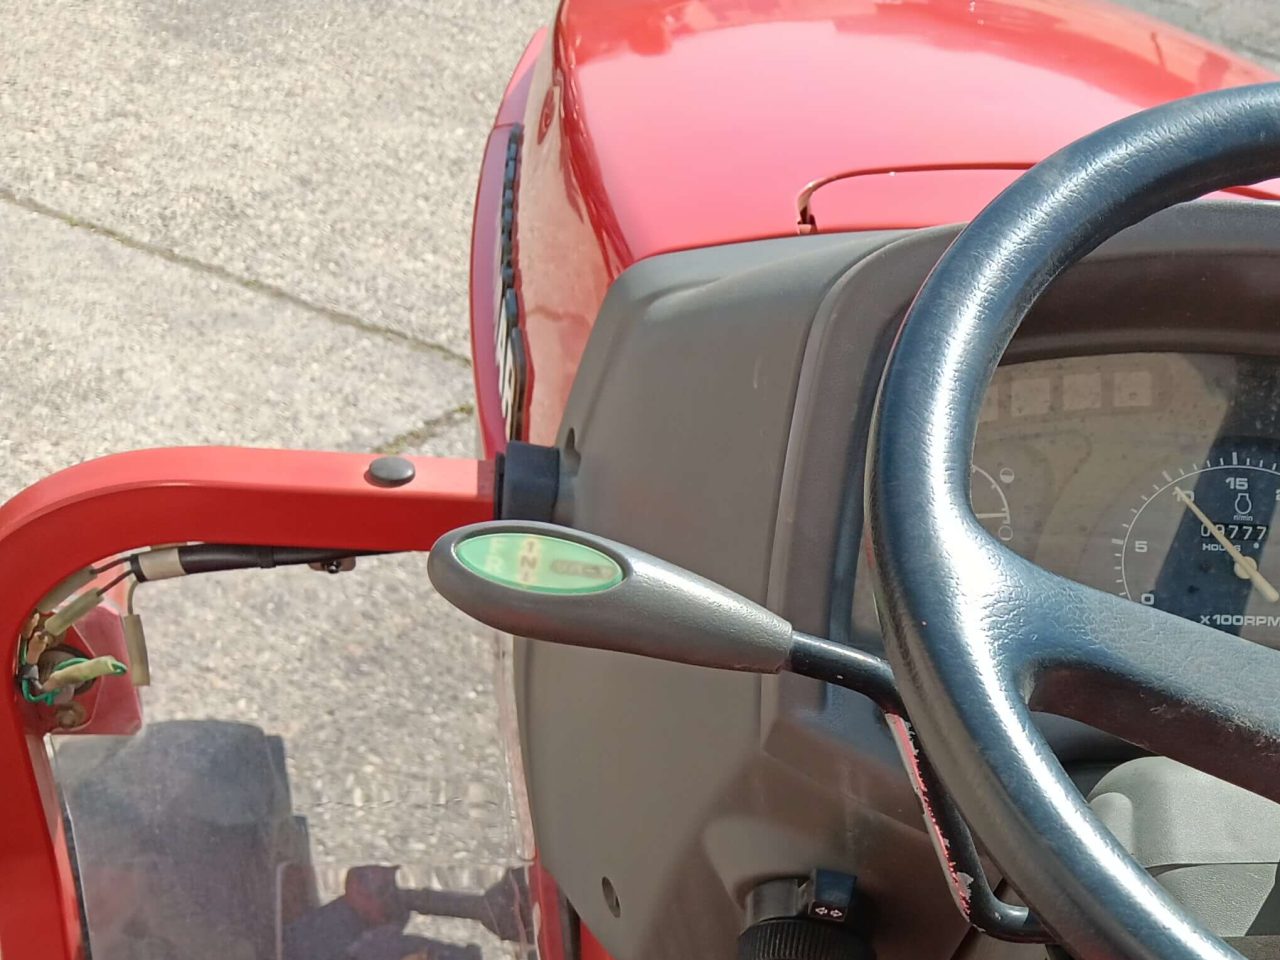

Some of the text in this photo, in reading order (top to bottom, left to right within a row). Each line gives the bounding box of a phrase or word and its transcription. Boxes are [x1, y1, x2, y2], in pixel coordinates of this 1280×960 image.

[1225, 477, 1248, 490] 15
[1134, 541, 1147, 552] 5
[1141, 593, 1155, 605] 0
